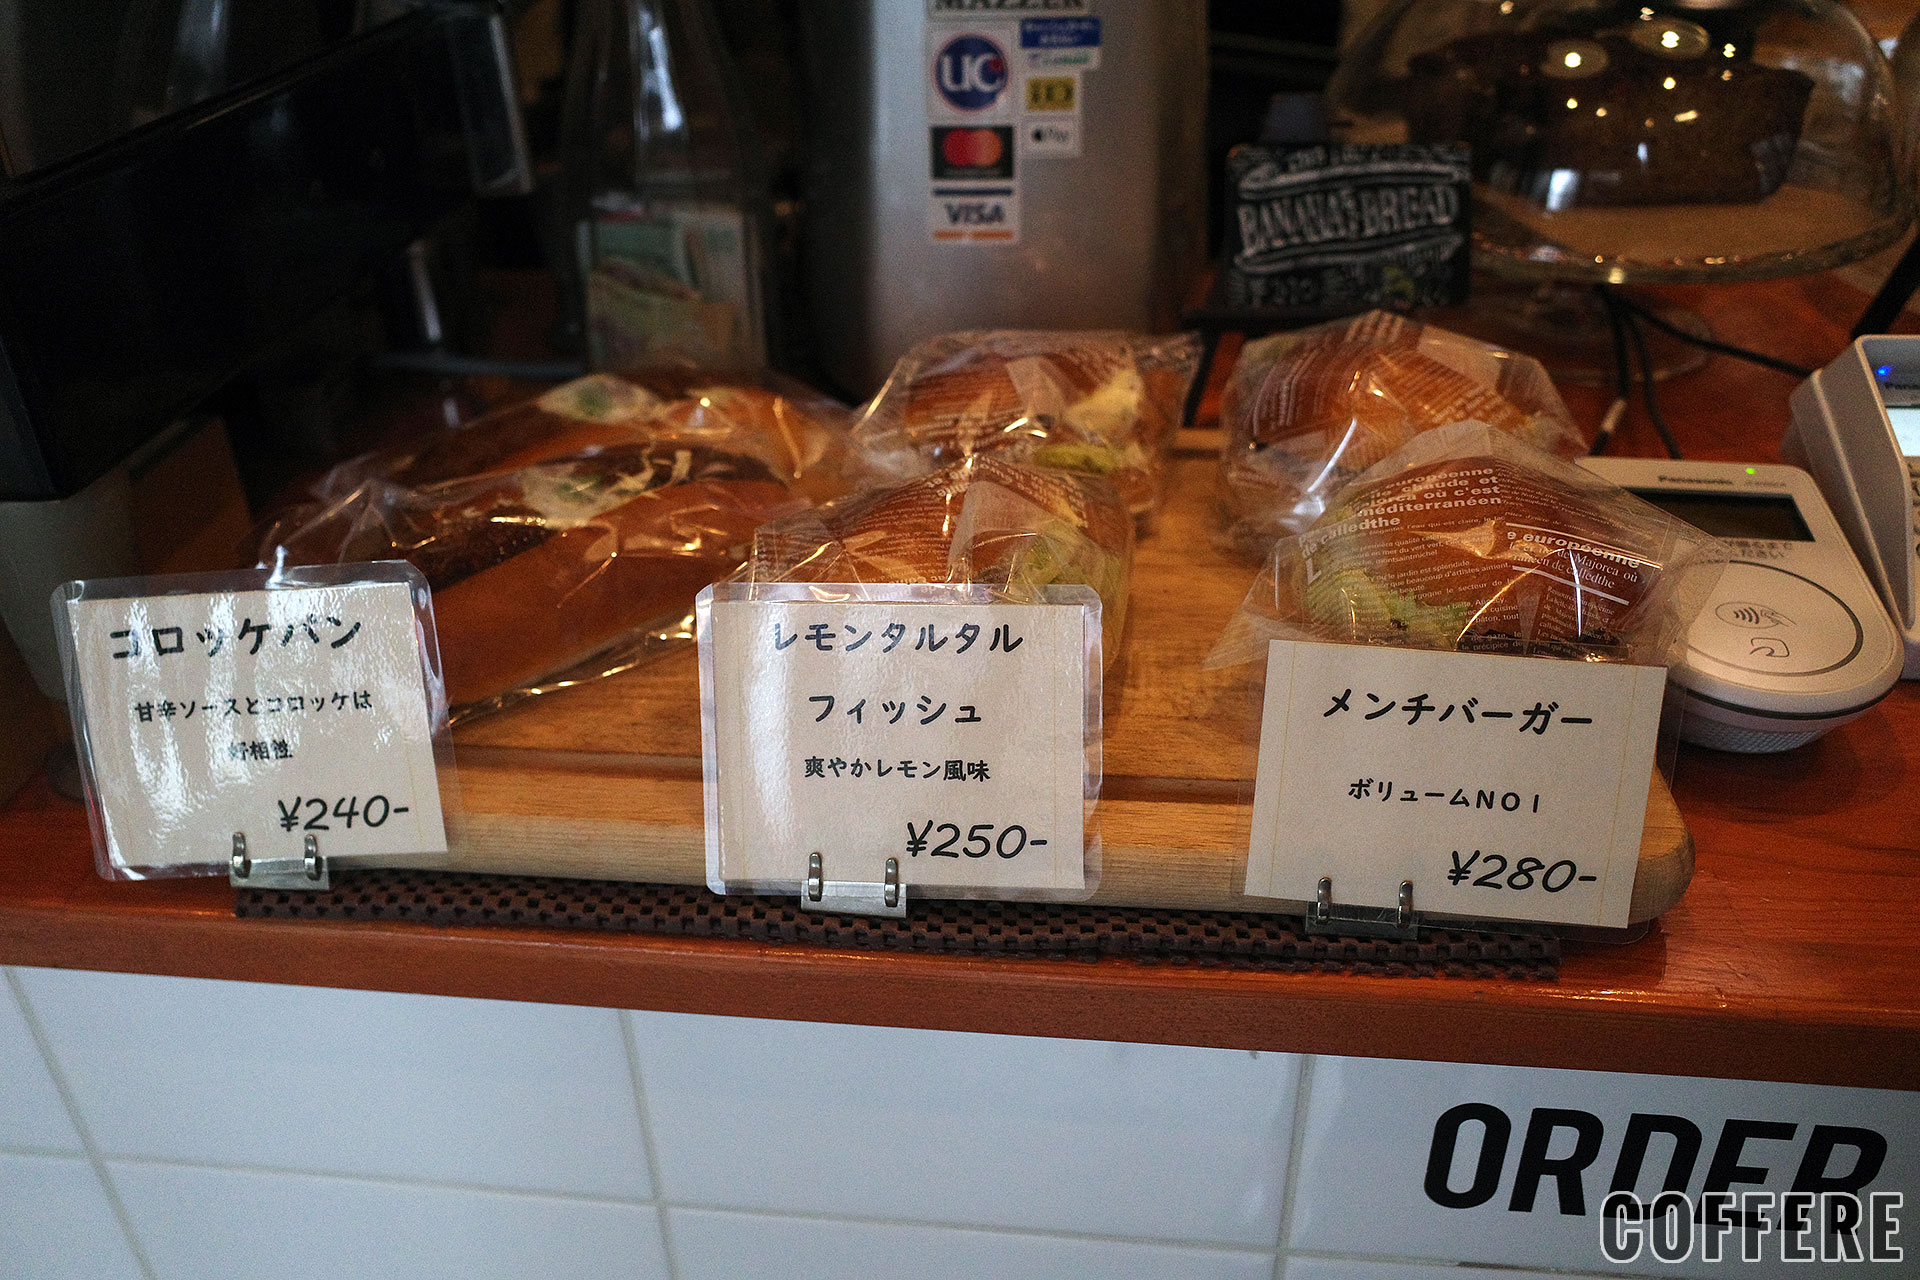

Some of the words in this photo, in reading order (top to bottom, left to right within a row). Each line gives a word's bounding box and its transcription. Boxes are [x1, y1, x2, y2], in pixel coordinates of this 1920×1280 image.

[941, 53, 1001, 93] UC
[946, 203, 1004, 225] VISA
[1423, 489, 1448, 500] où
[1453, 485, 1500, 497] c'est
[1478, 475, 1499, 485] et
[1357, 497, 1502, 517] méditerranéen
[1573, 553, 1620, 577] Majorca
[1623, 571, 1638, 583] où
[774, 623, 1023, 653] レモンタルタル
[135, 690, 373, 722] 甘辛ソースとコロッケは
[808, 695, 982, 725] フィッシュ
[1323, 688, 1593, 734] メンチバーガー
[230, 739, 293, 761] 好相性
[804, 757, 991, 782] 爽やかレモン風味
[278, 795, 409, 832] ¥240-
[906, 820, 1047, 859] ¥250-
[1447, 849, 1597, 893] ¥280-
[1423, 1102, 1888, 1236] ORDER
